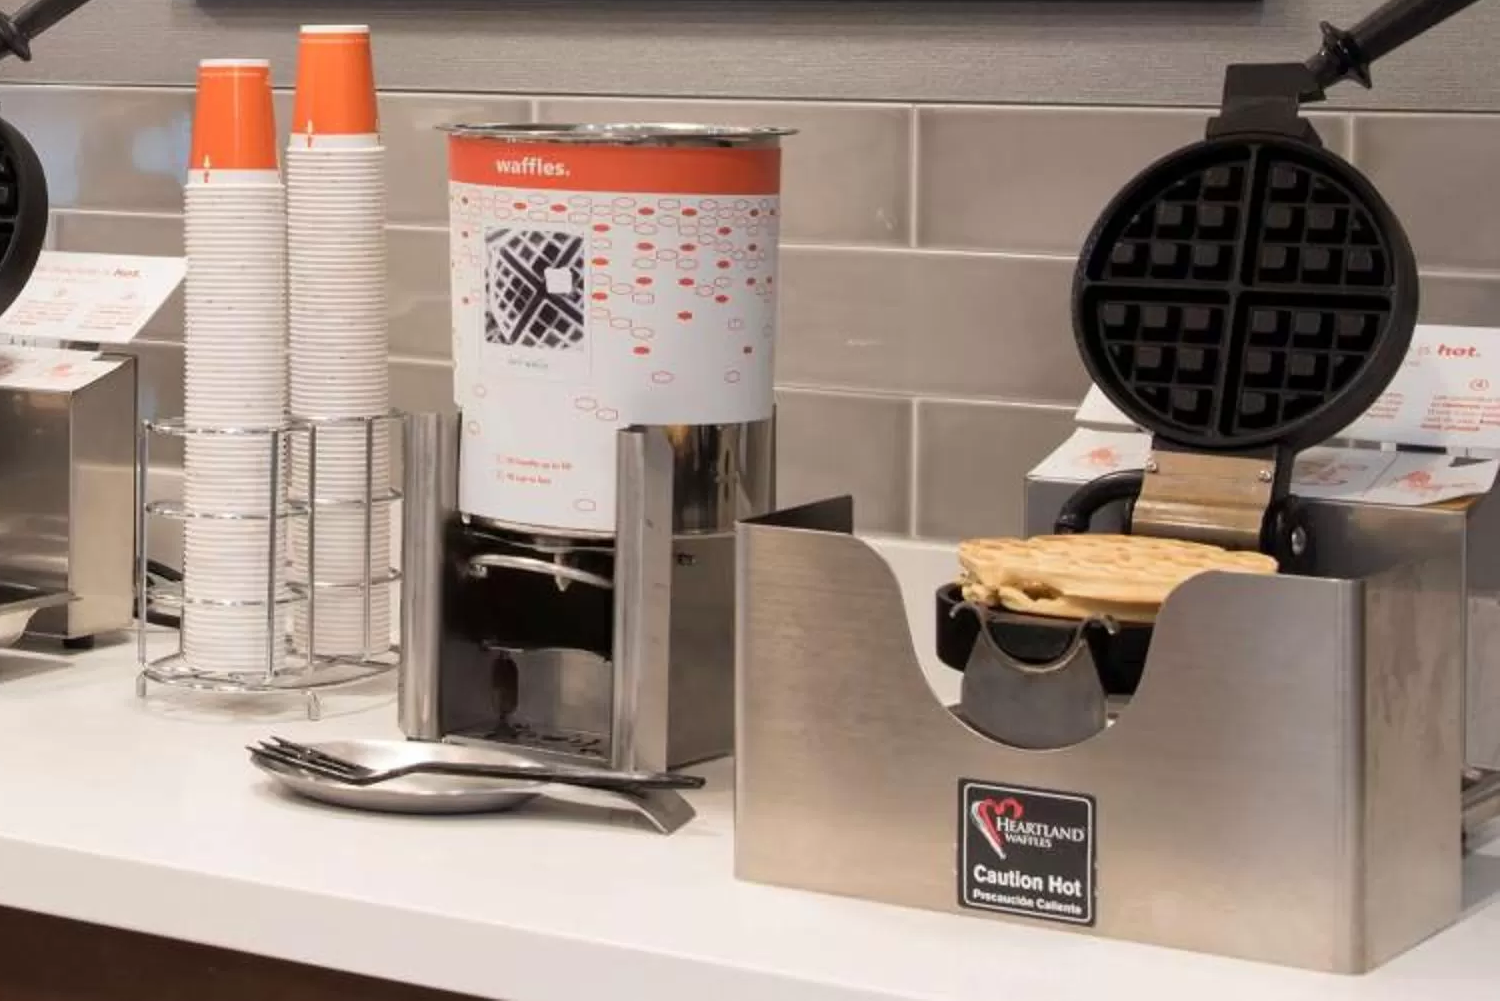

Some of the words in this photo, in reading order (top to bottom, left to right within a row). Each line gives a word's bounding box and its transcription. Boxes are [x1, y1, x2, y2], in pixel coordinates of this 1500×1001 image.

[495, 156, 571, 177] waffles.
[996, 816, 1085, 843] HEARTLAND
[973, 864, 1044, 892] Caution
[1048, 875, 1082, 898] Hot
